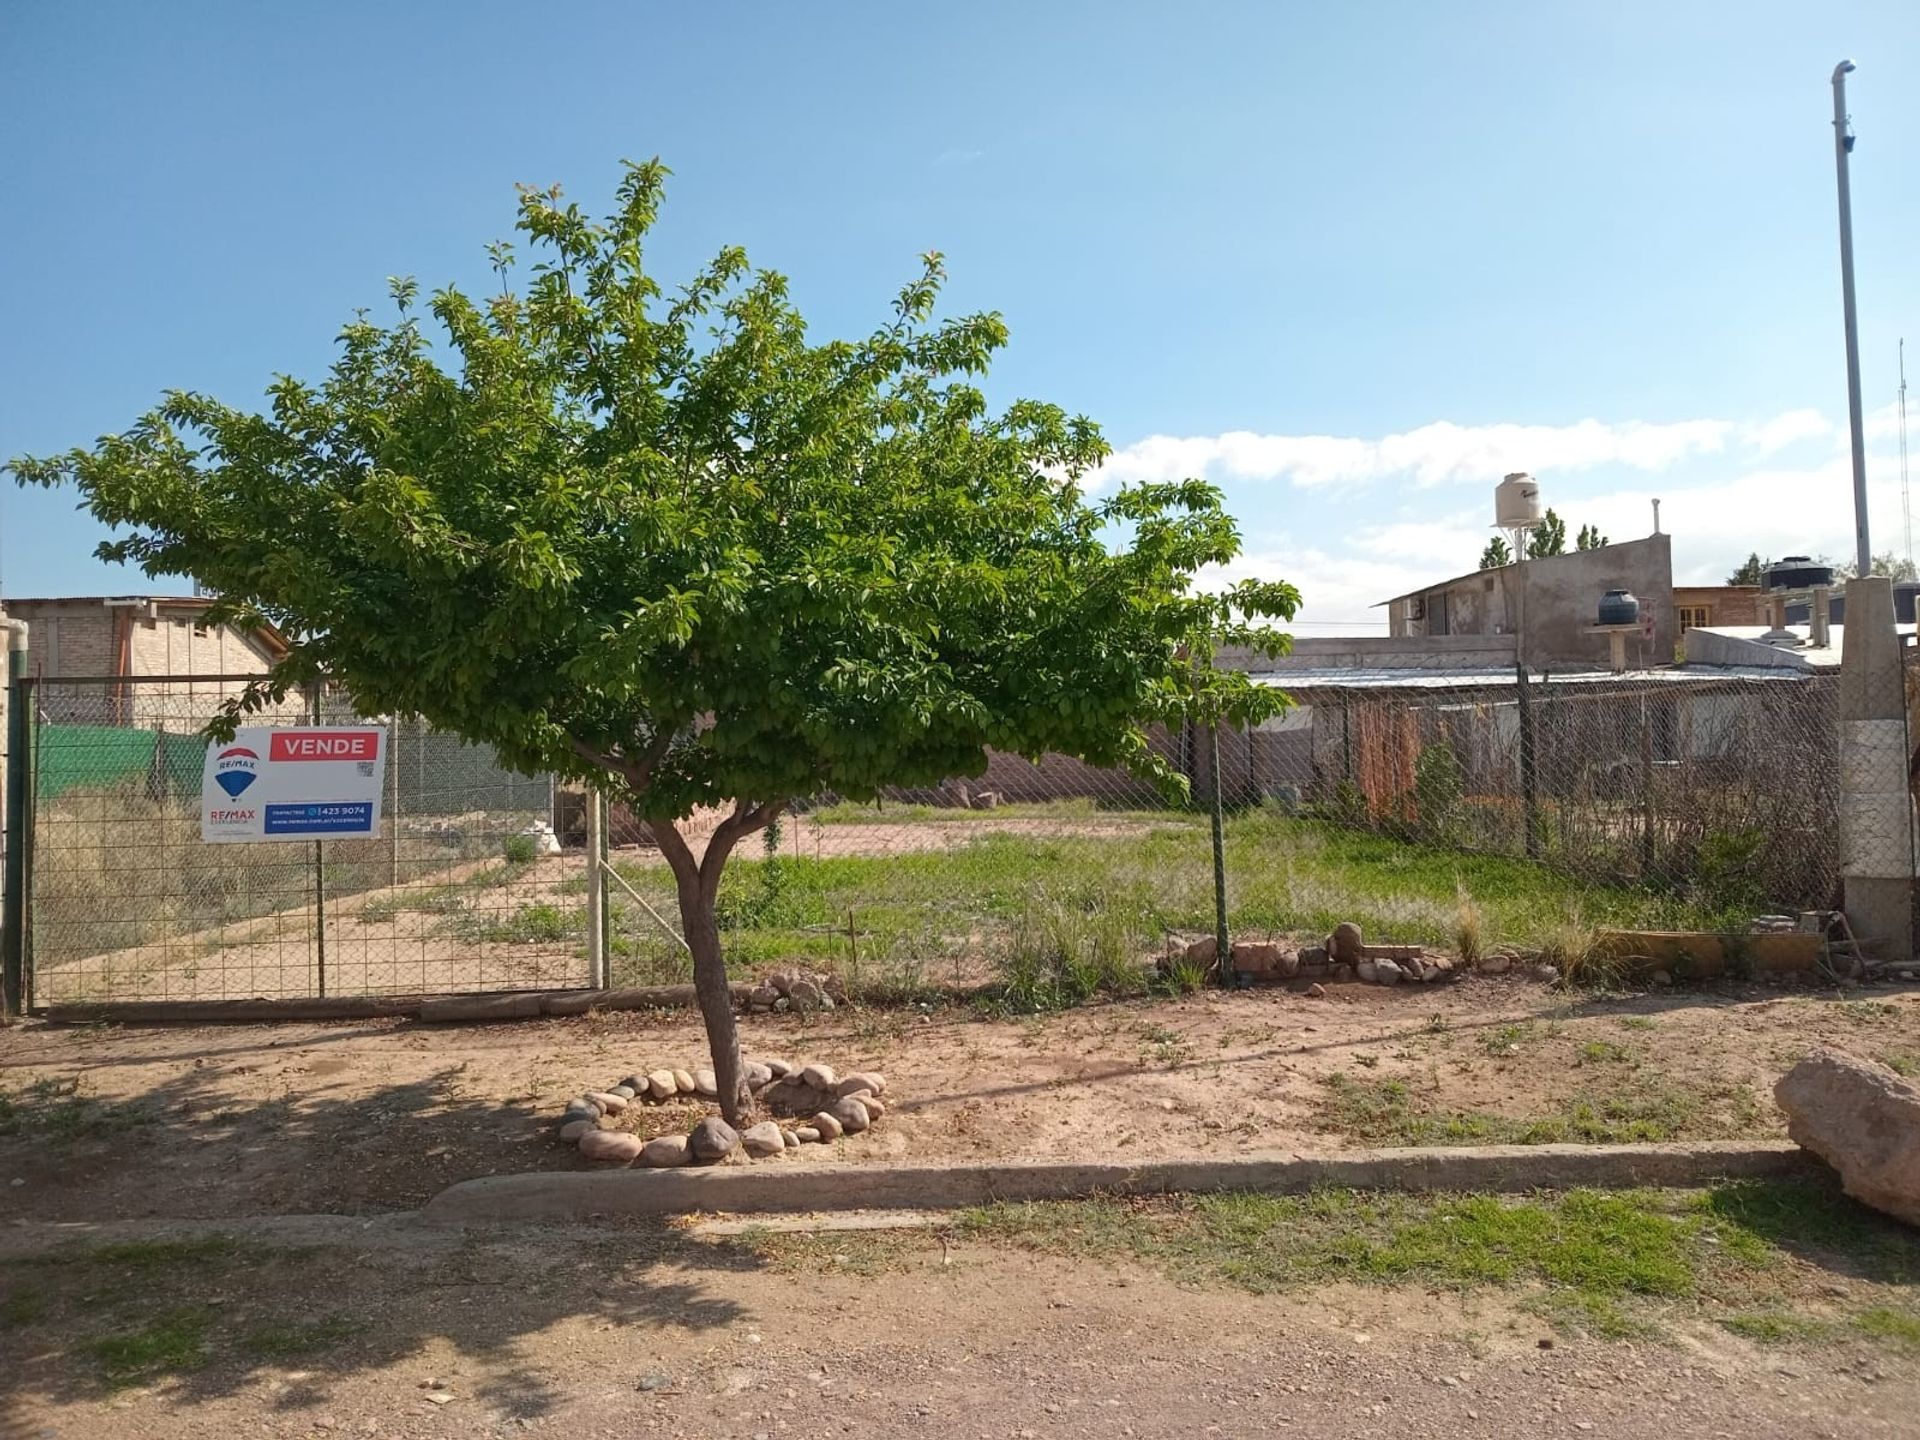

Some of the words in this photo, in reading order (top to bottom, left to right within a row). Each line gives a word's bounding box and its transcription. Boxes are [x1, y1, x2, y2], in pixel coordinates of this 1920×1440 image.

[284, 738, 366, 755] VENDE
[219, 760, 255, 770] RE/MAX
[210, 809, 255, 819] RE/MAX
